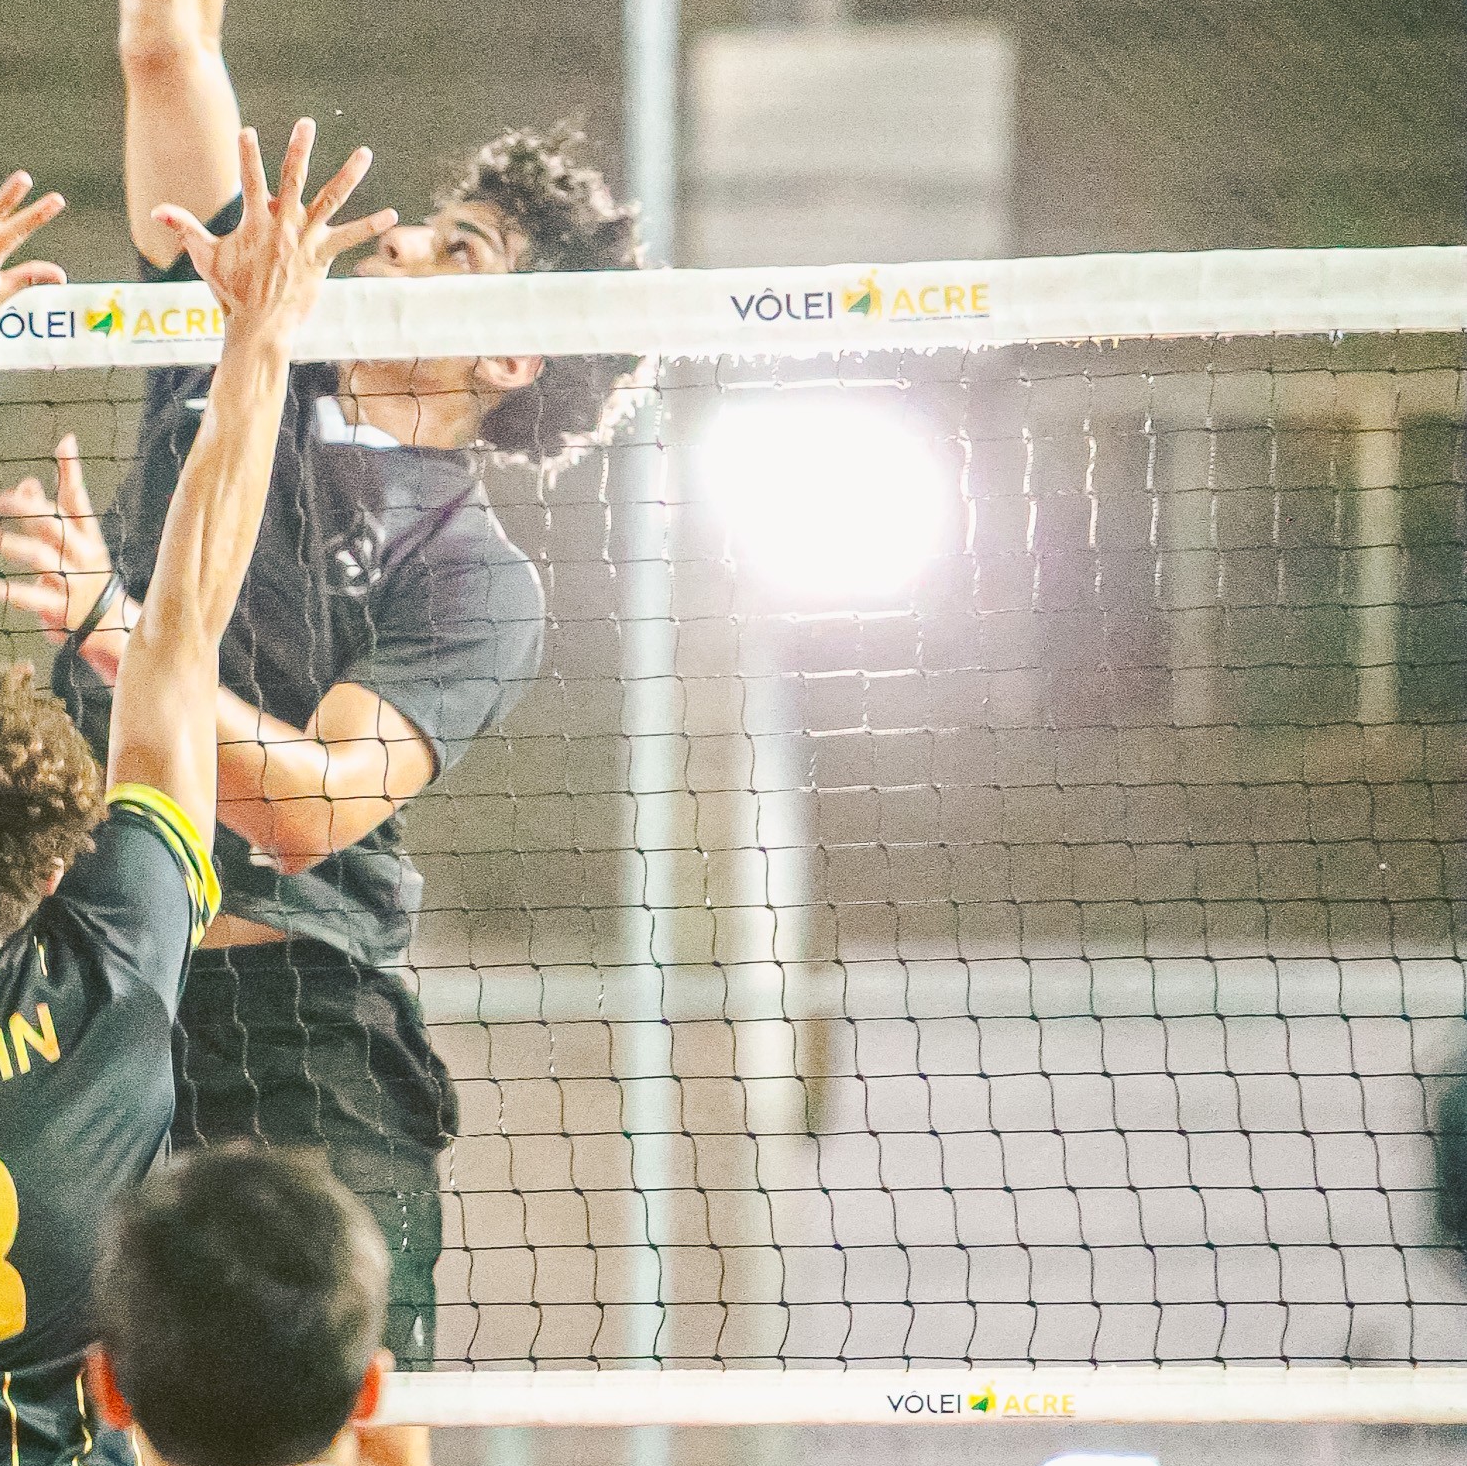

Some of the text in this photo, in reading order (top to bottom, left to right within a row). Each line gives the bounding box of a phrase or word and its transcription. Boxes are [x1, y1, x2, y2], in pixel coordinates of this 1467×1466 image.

[730, 284, 990, 322] VÔLEI ACRE
[887, 1390, 1075, 1414] VÔLEI ACRE
